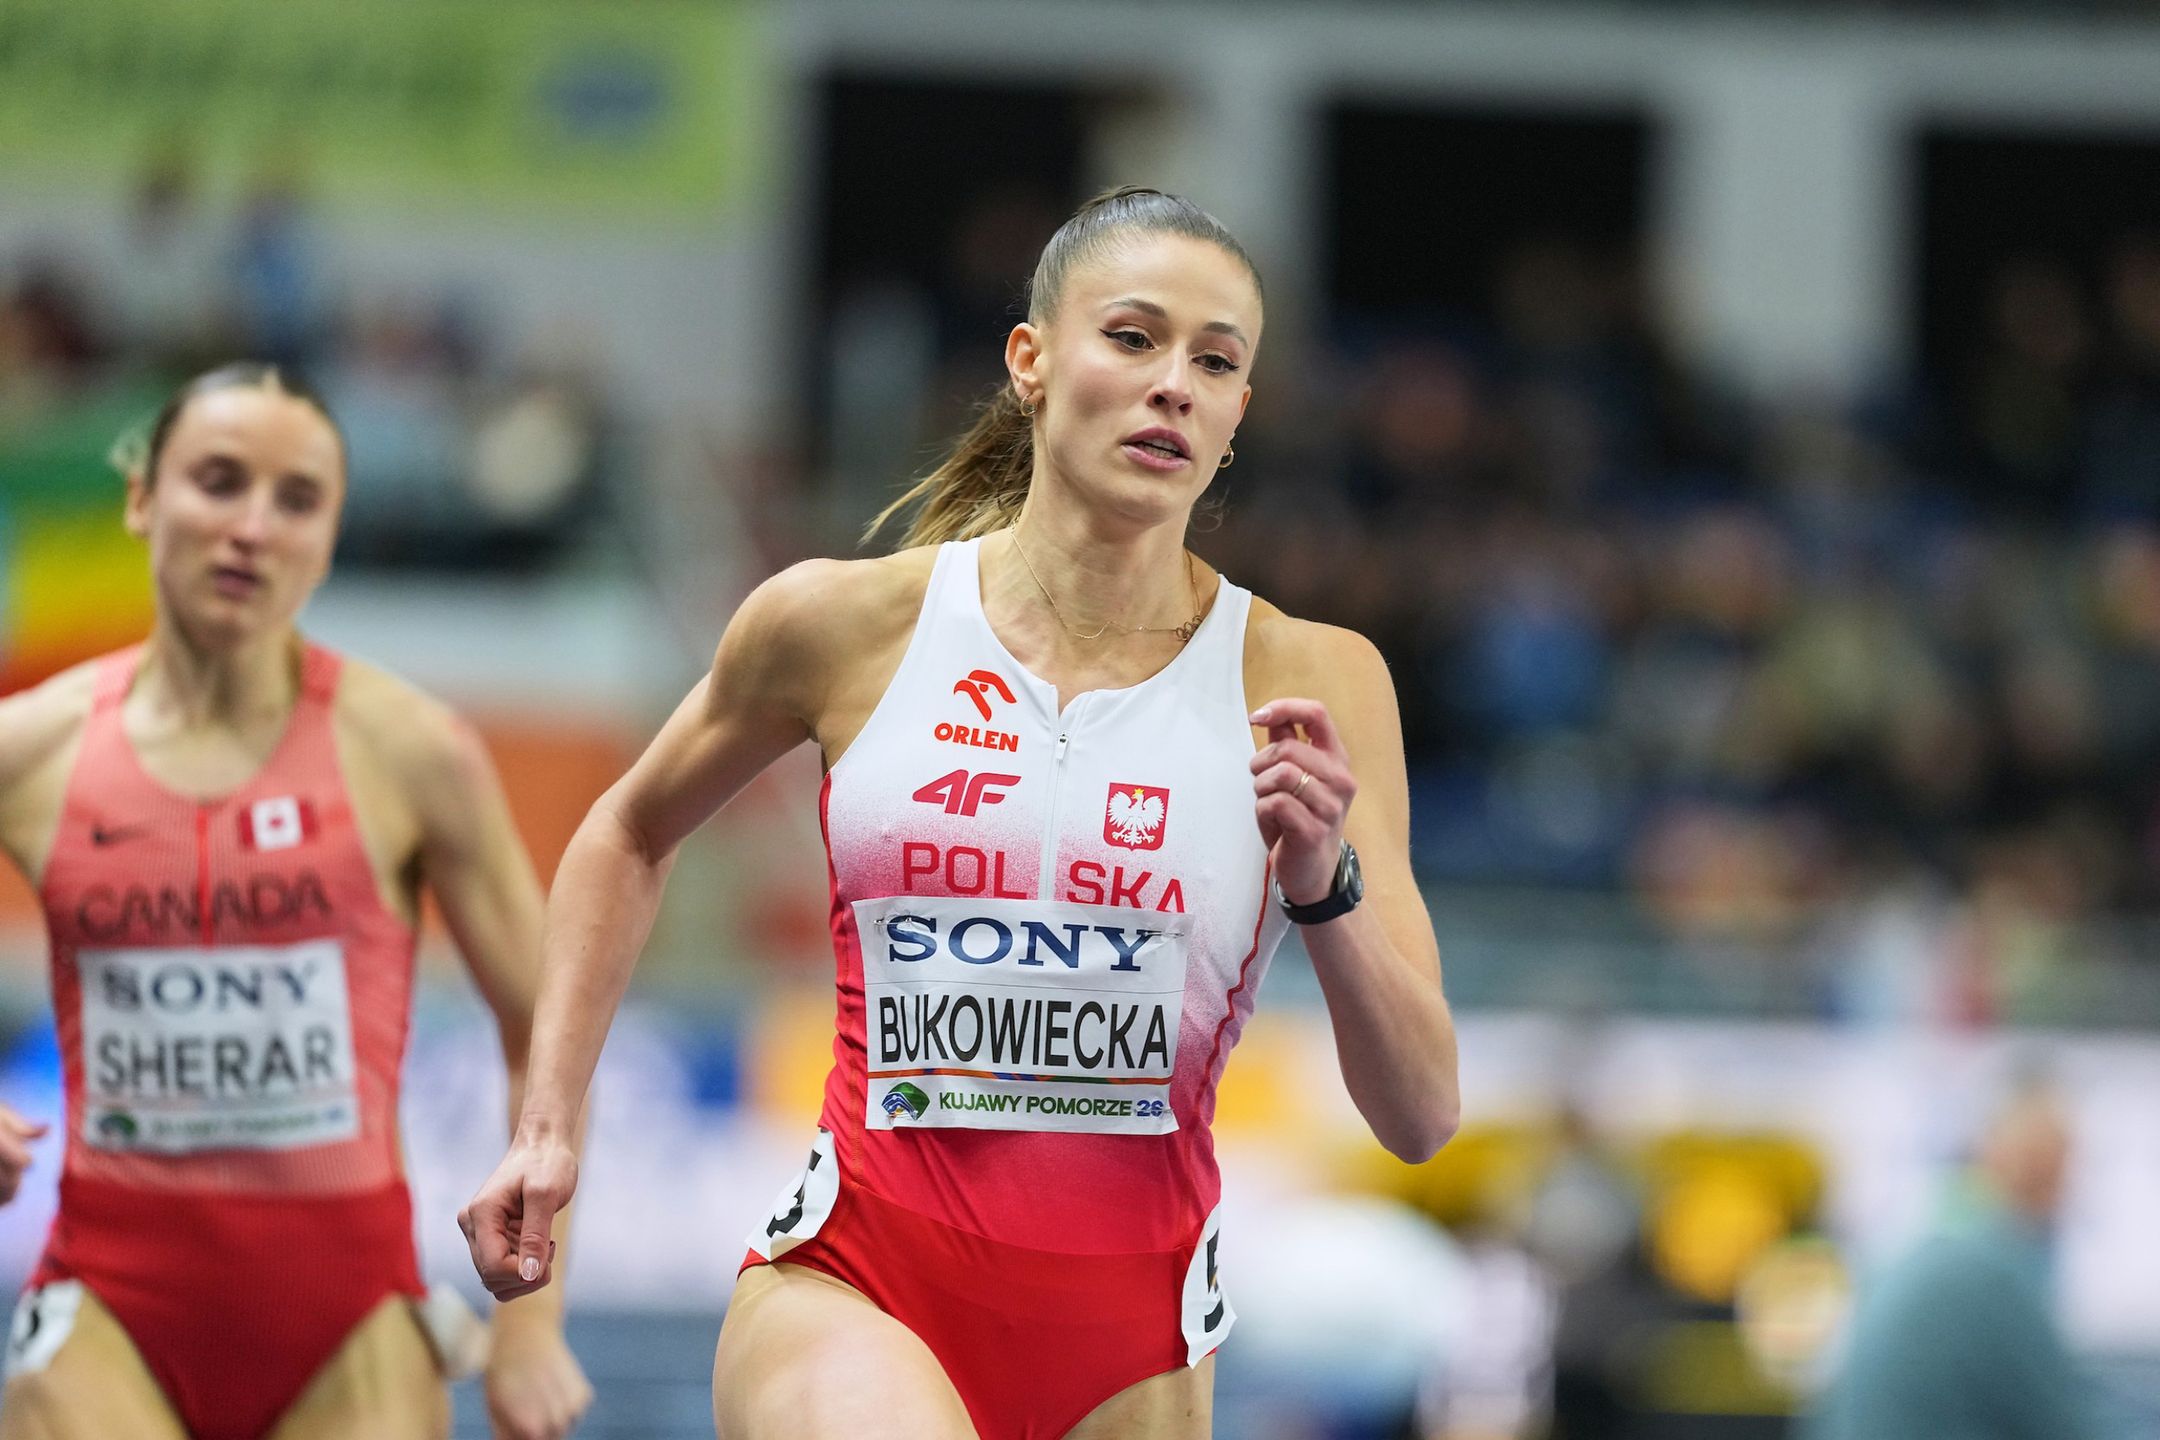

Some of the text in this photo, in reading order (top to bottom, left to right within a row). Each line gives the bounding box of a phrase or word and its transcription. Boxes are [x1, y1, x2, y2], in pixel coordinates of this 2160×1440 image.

[934, 723, 1019, 752] ORLEN
[912, 769, 1022, 817] 4F
[77, 867, 334, 940] CANADA
[886, 914, 1158, 972] SONY
[103, 958, 318, 1015] SONY
[97, 1024, 335, 1093] SHERAR
[879, 993, 1169, 1070] BUKOWIECKA
[938, 1091, 1023, 1113] KUJAWY
[1026, 1095, 1132, 1117] POMORZE
